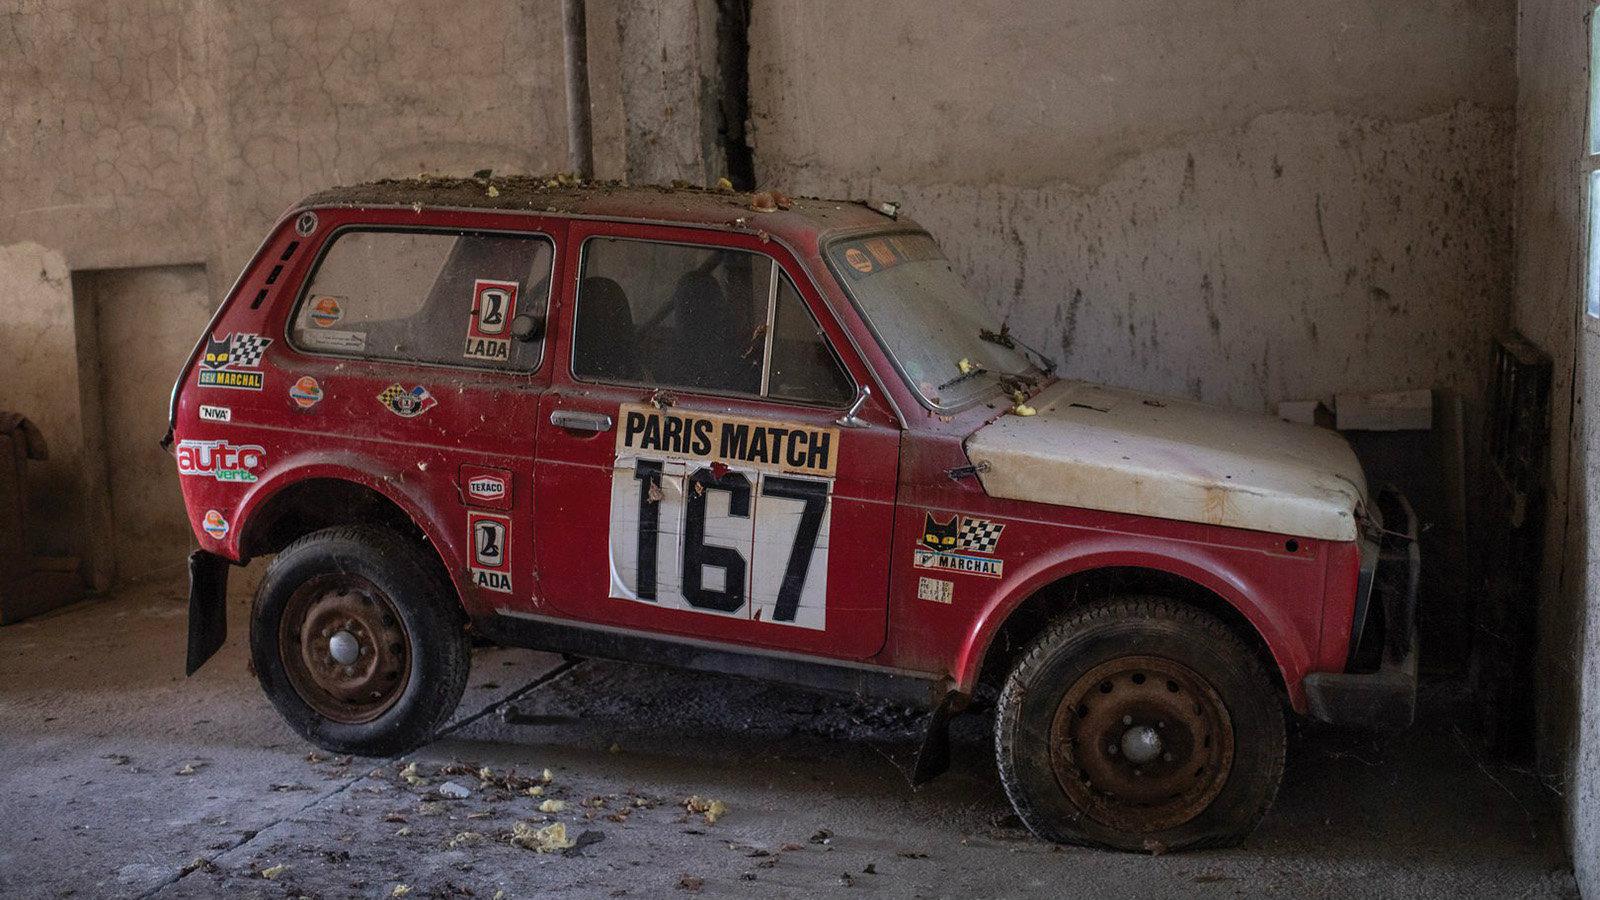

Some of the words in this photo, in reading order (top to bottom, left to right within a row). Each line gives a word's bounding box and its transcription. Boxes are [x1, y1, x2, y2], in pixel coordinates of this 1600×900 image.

[466, 338, 508, 357] LADA
[216, 372, 260, 387] MARCHAL
[624, 411, 713, 456] PARIS
[719, 423, 830, 470] MATCH
[179, 443, 264, 471] auto
[215, 468, 257, 481] verte
[471, 483, 503, 493] TEXACO
[633, 457, 831, 622] 167
[939, 556, 997, 574] MARCHAL
[474, 570, 511, 590] ADA
